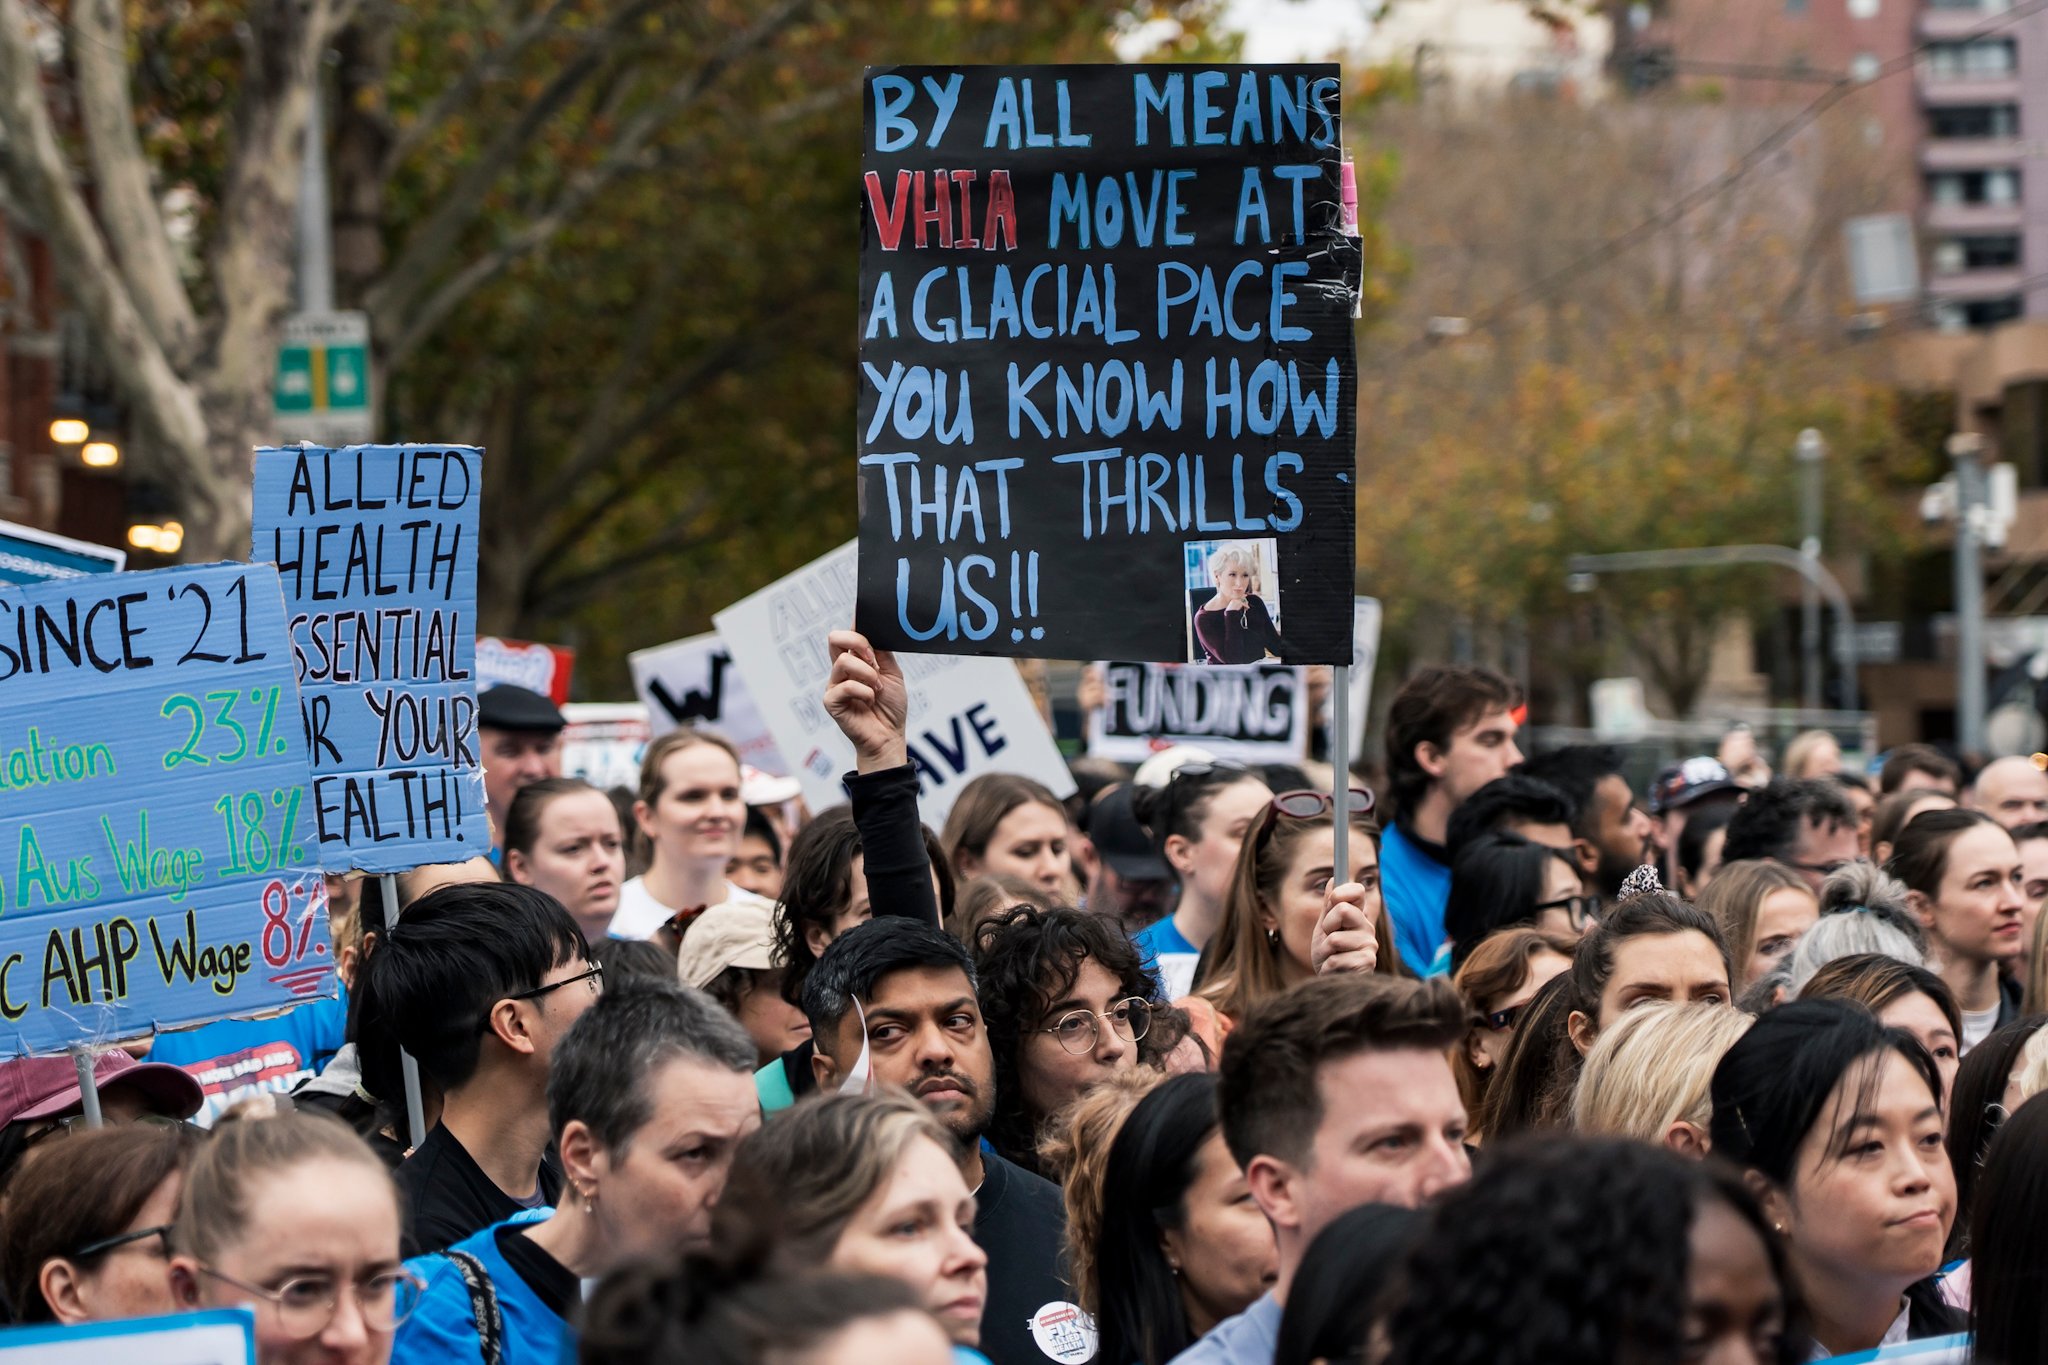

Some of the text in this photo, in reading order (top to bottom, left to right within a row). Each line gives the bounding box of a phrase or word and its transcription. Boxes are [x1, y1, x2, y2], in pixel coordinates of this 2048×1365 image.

[872, 70, 1339, 152] BY ALL MEANS
[864, 165, 1322, 250] VHIA MOVE AT
[865, 260, 1313, 345] A GLACIAL PACE
[861, 356, 1340, 445] YOU KNOW HOW
[288, 451, 470, 517] ALLIED
[859, 448, 1305, 543] THAT THRILLS
[275, 520, 462, 601] HEALTH
[896, 550, 1045, 644] US!!
[0, 575, 267, 681] SINCE '21
[288, 608, 471, 683] SSENTIAL
[160, 685, 287, 770] 23%
[364, 688, 478, 770] YOUR
[1105, 664, 1291, 737] FUNDING
[843, 702, 1006, 800] AVE
[16, 825, 102, 909] Aus
[101, 809, 204, 903] Wage
[214, 785, 304, 877] 18%
[313, 769, 464, 847] EALTH!
[42, 916, 139, 1008] AHP
[148, 908, 251, 995] Wage
[261, 880, 327, 968] 8%
